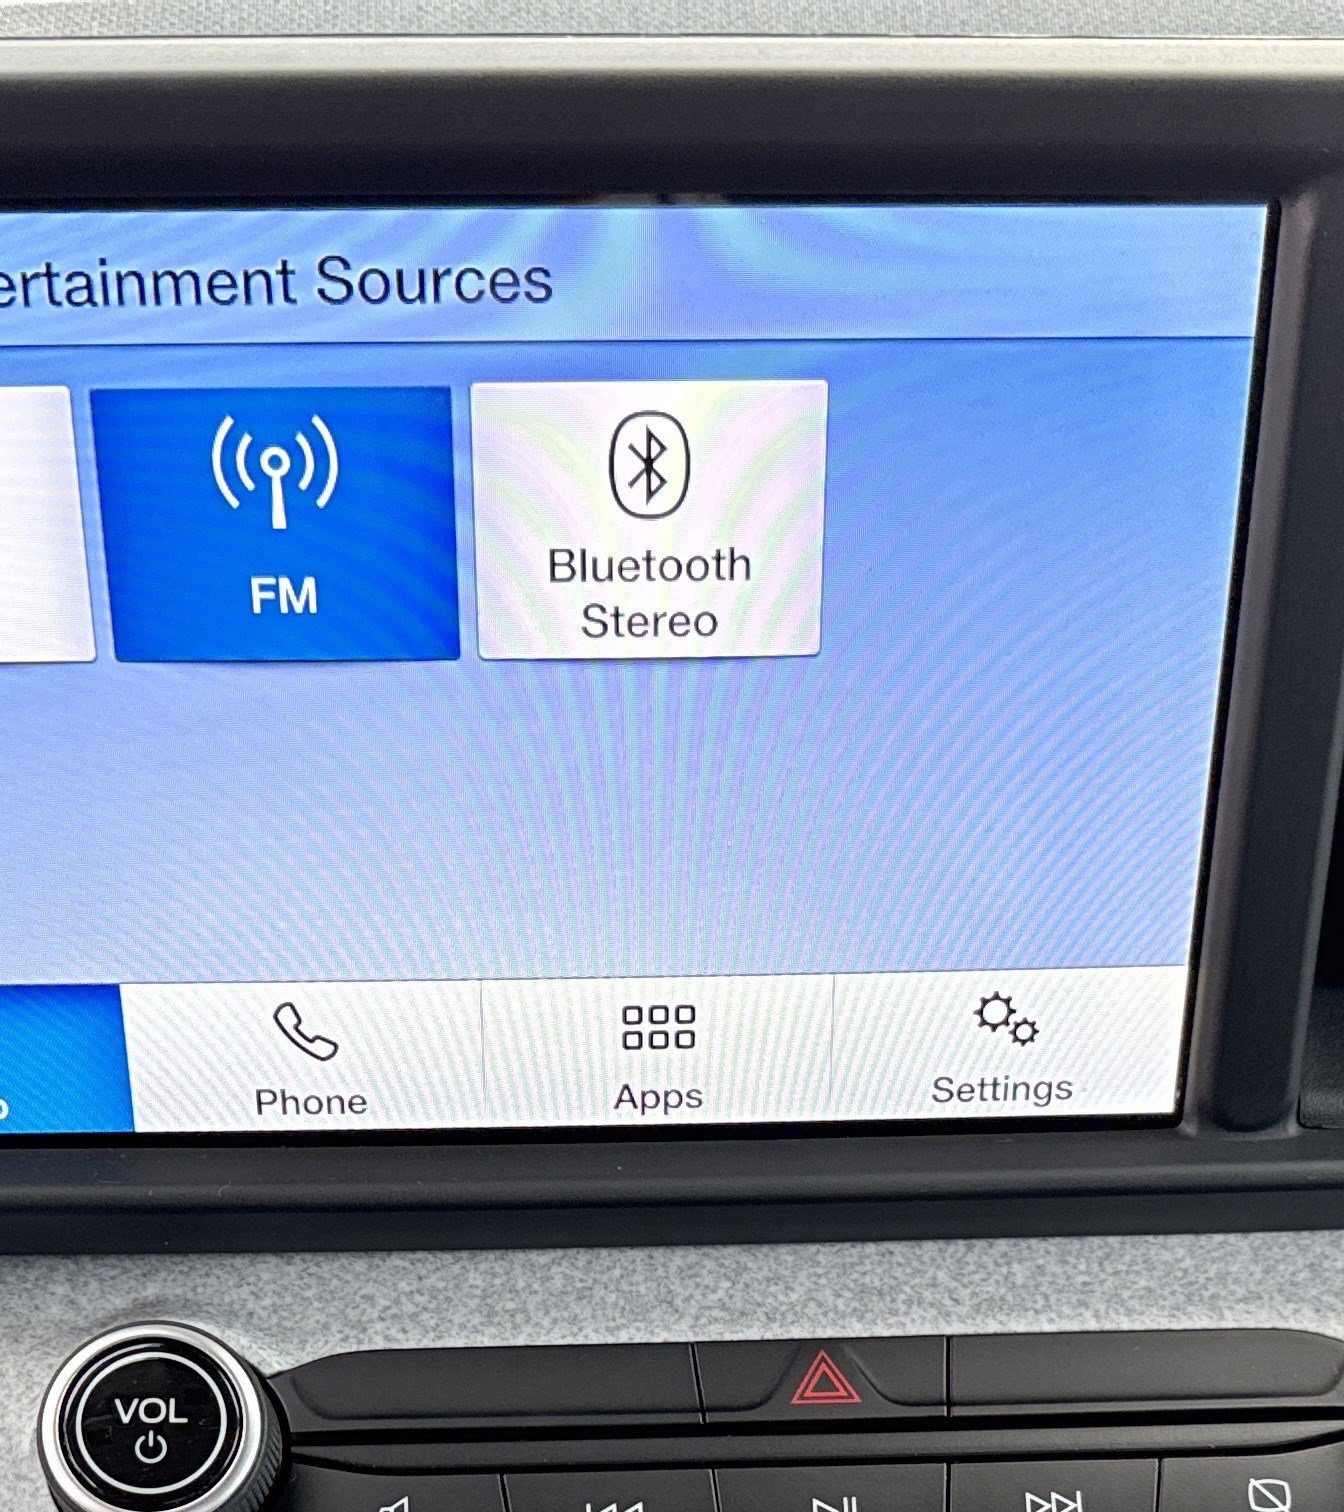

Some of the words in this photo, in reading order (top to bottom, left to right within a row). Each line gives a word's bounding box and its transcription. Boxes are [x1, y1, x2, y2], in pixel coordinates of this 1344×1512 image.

[317, 255, 553, 306] Sources
[549, 546, 751, 584] Bluetooth
[250, 576, 318, 614] FM
[581, 602, 719, 639] Stereo
[255, 1085, 368, 1116] Phone
[613, 1082, 703, 1117] Apps
[931, 1070, 1073, 1108] Settings
[114, 1397, 189, 1424] VOL
